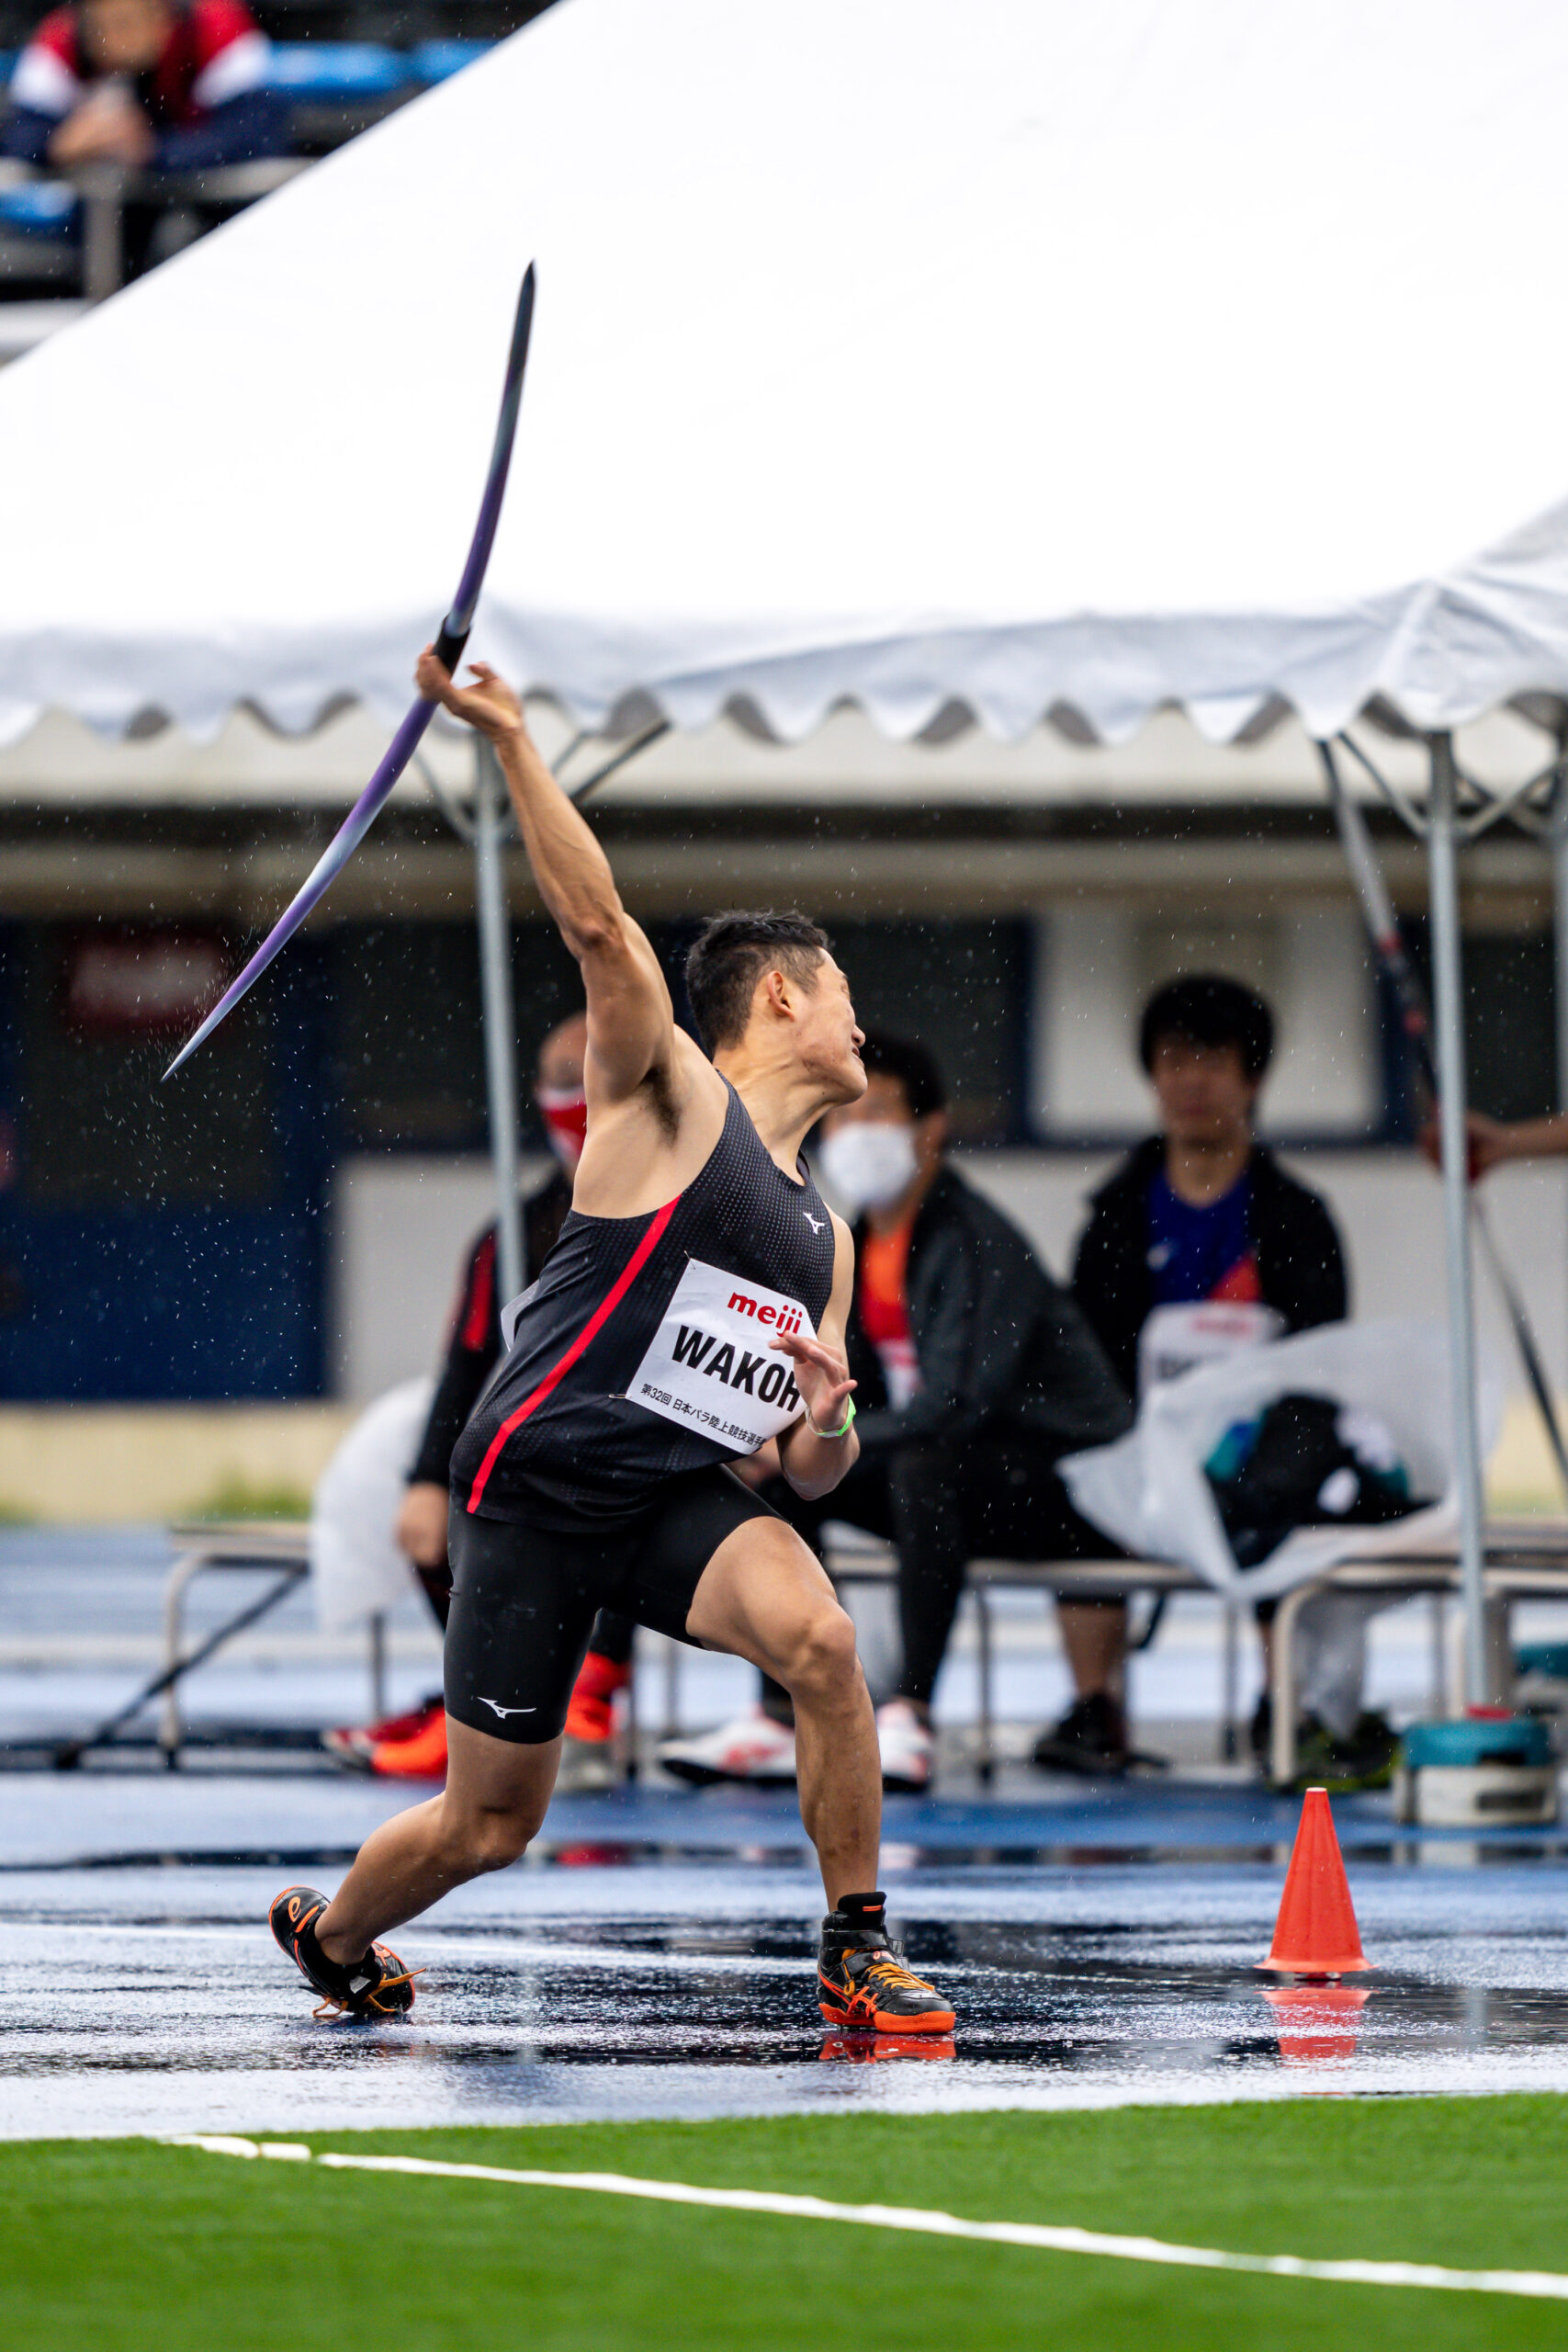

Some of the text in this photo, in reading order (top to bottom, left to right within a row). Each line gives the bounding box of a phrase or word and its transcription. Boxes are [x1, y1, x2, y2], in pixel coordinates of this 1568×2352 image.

[728, 1292, 803, 1338] meiji
[671, 1325, 801, 1413] WAKOH
[640, 1383, 672, 1407] 第32回
